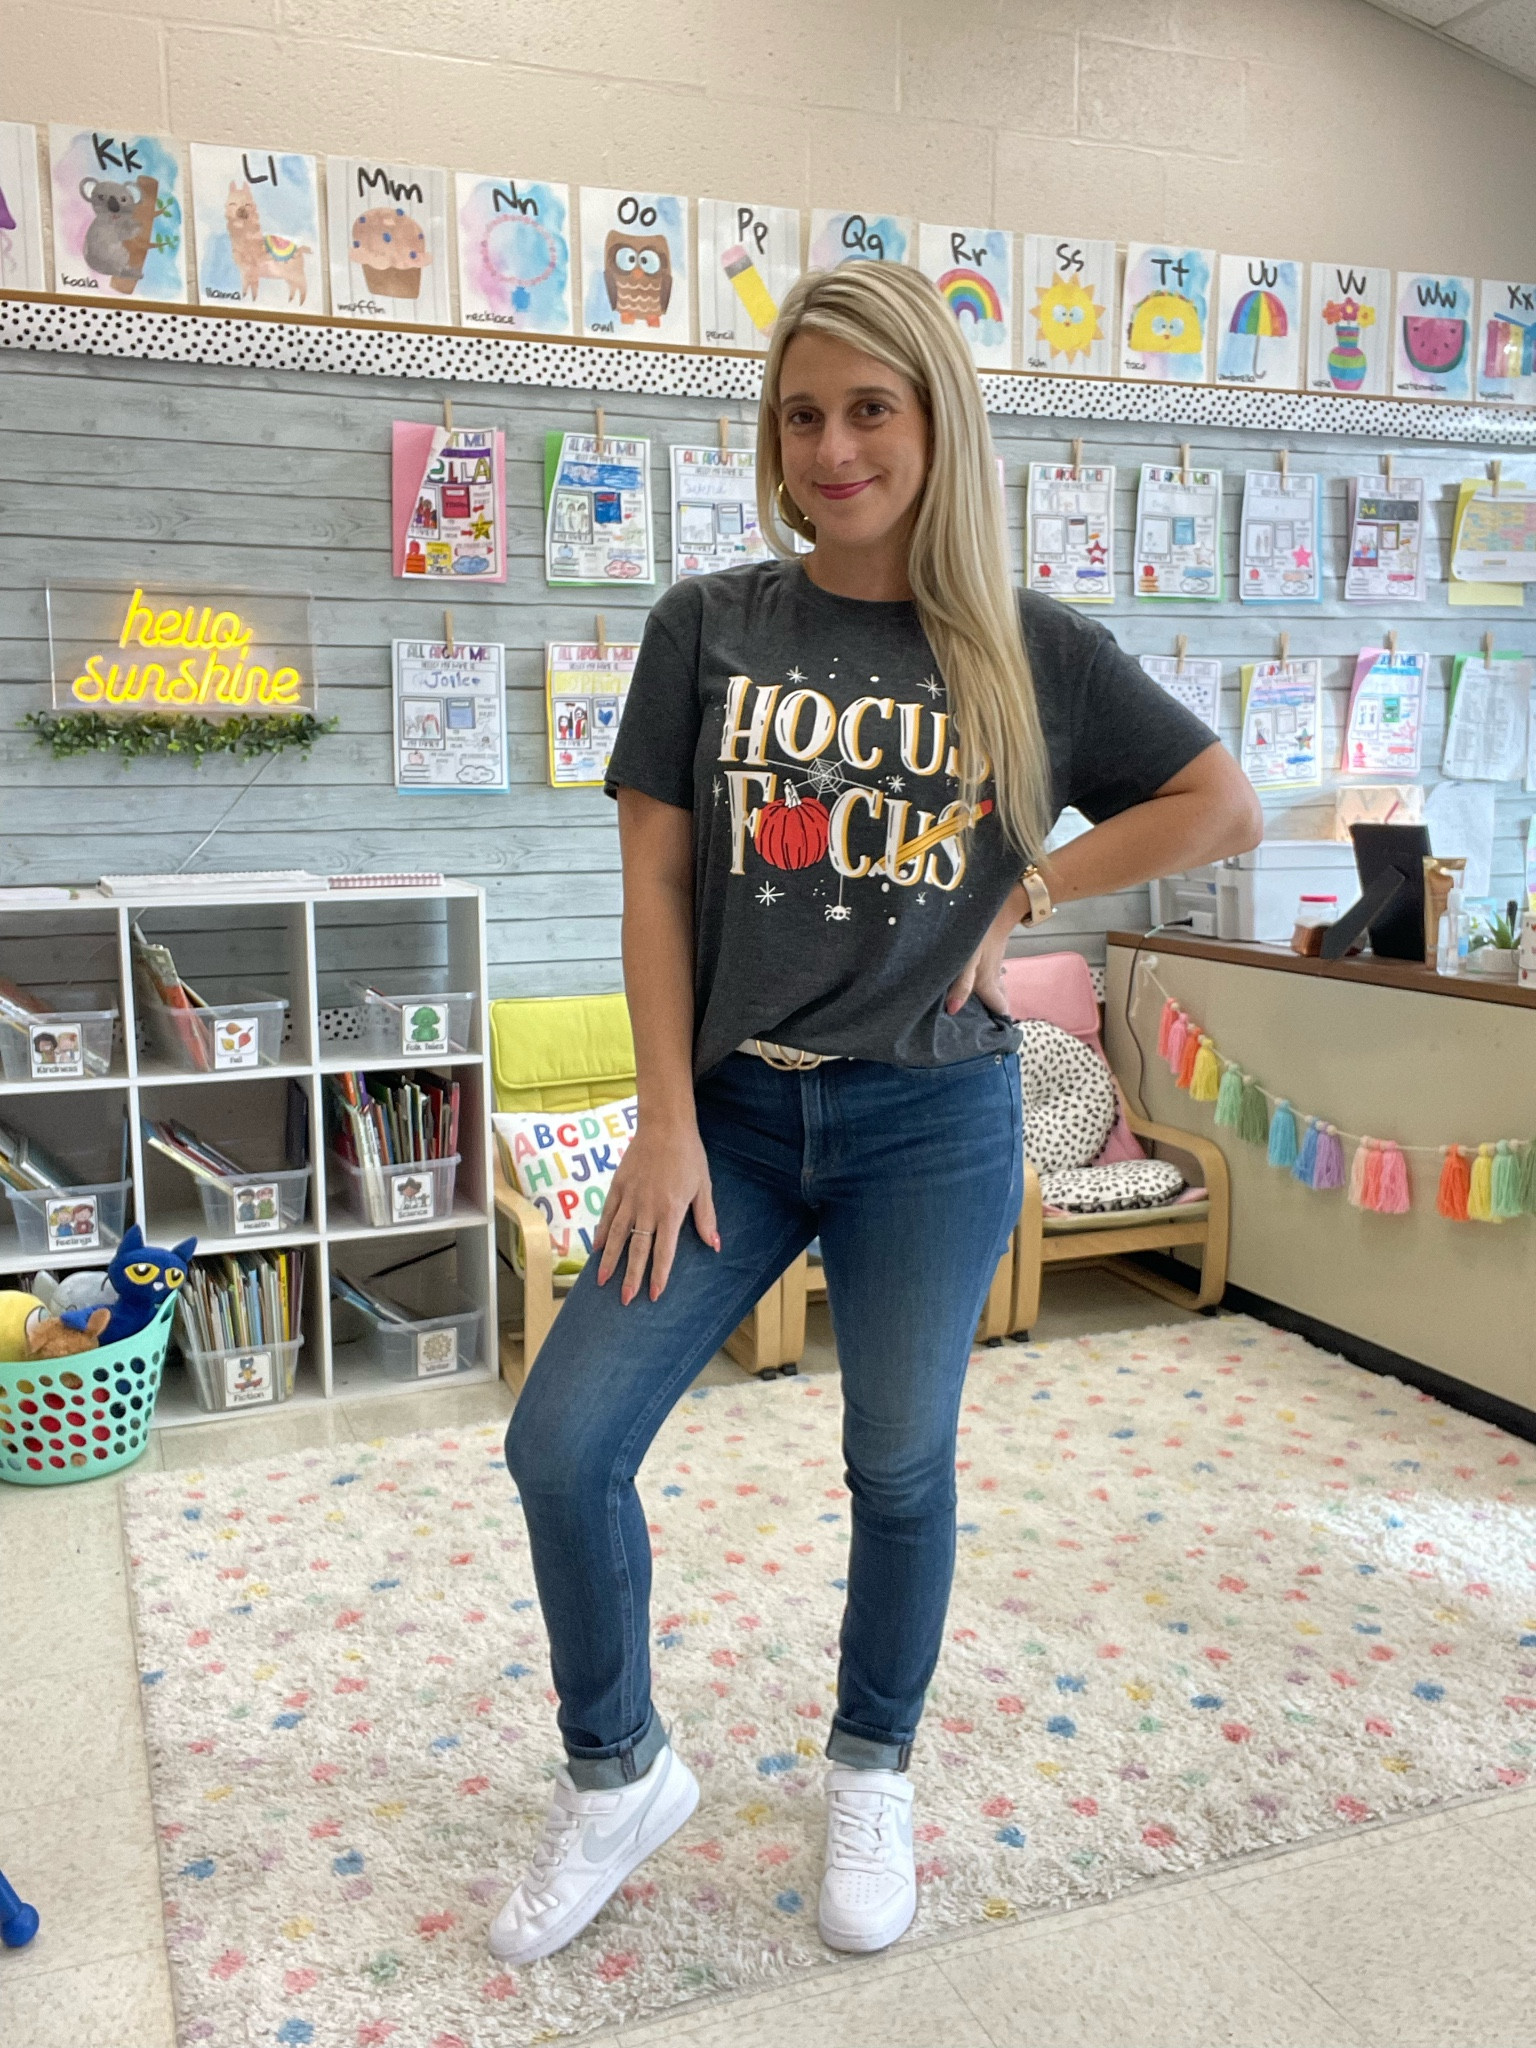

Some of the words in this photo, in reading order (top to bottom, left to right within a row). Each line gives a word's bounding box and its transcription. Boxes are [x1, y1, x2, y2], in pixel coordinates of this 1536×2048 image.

[92, 132, 143, 172] Kk
[356, 166, 424, 203] Mm
[491, 180, 539, 217] Nn
[616, 196, 658, 227] Oo
[737, 207, 768, 255] Pp
[841, 214, 885, 261] Qq
[950, 232, 988, 267] Rr
[1055, 243, 1085, 273] Ss
[1150, 257, 1190, 287] Tt
[1247, 260, 1279, 288] Uu
[1336, 268, 1367, 296] Vv
[1416, 280, 1458, 310] Ww
[1507, 284, 1536, 310] Xx
[71, 645, 302, 706] sunshine
